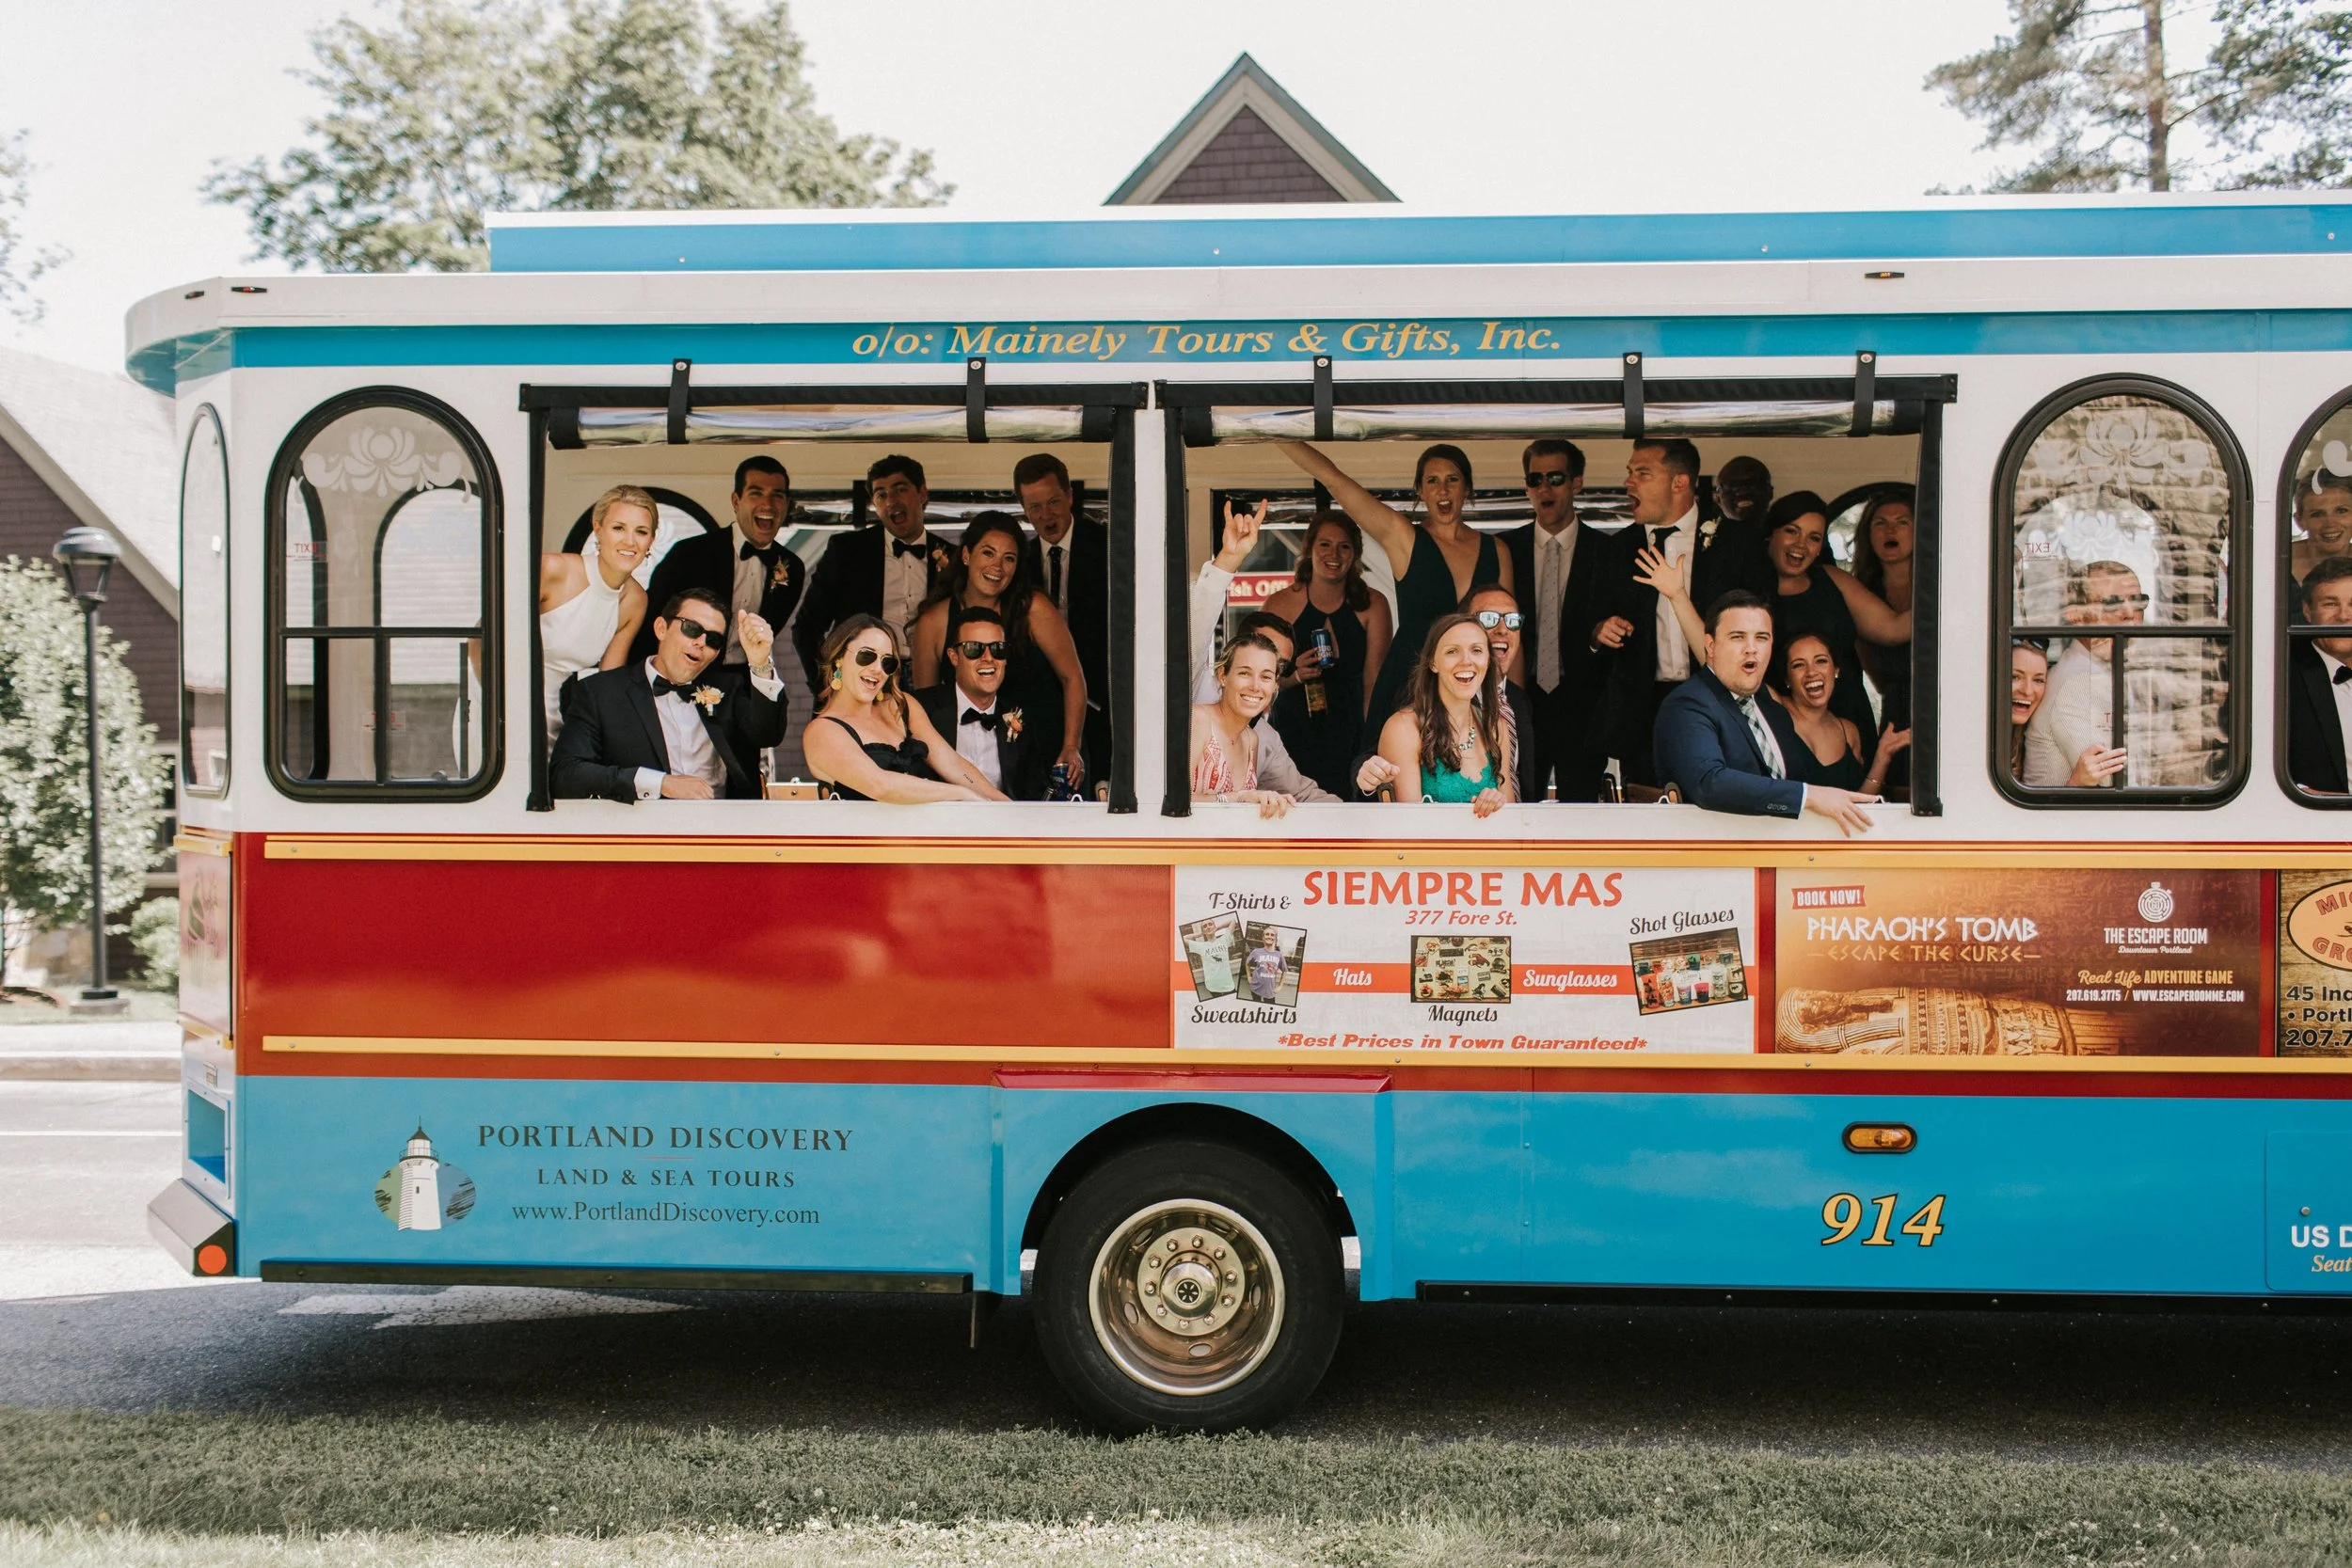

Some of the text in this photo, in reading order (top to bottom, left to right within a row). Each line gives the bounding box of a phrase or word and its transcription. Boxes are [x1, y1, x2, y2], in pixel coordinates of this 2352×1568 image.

[851, 321, 1562, 361] o/o: Mainely Tours & Gifts, Inc.
[1304, 871, 1623, 907] SIEMPRE MAS
[1797, 888, 1860, 907] BOOK NOW!
[1209, 892, 1291, 910] T-Shirts &
[1405, 910, 1518, 926] 377 Fore St.
[1629, 909, 1735, 935] Shot Glasses
[1806, 916, 2039, 942] PHARAOH'S TOMB
[2104, 927, 2208, 944] THE ESCAPE ROOM
[1910, 944, 1951, 962] THE
[2118, 945, 2192, 954] Downtown Portland
[1332, 968, 1373, 986] Hats
[1522, 969, 1617, 991] Sunglasses
[2077, 970, 2233, 988] Real Life ADVENTURE GAME
[2066, 990, 2122, 1002] 207.619.3775
[2132, 990, 2245, 1003] WWW.ESCAPEROOMME.COM
[2286, 986, 2314, 1001] 45
[1191, 1005, 1297, 1024] Sweatshirts
[1428, 1005, 1498, 1026] Magnets
[1343, 1034, 1413, 1048] Prices
[1421, 1035, 1442, 1049] in
[1449, 1035, 1504, 1049] Town
[478, 1125, 854, 1152] PORTLAND DISCOVERY
[537, 1168, 794, 1188] LAND & SEA TOURS
[512, 1201, 819, 1228] www.PortlandDiscovery.com
[1820, 1192, 1947, 1248] 914
[2291, 1225, 2329, 1248] US
